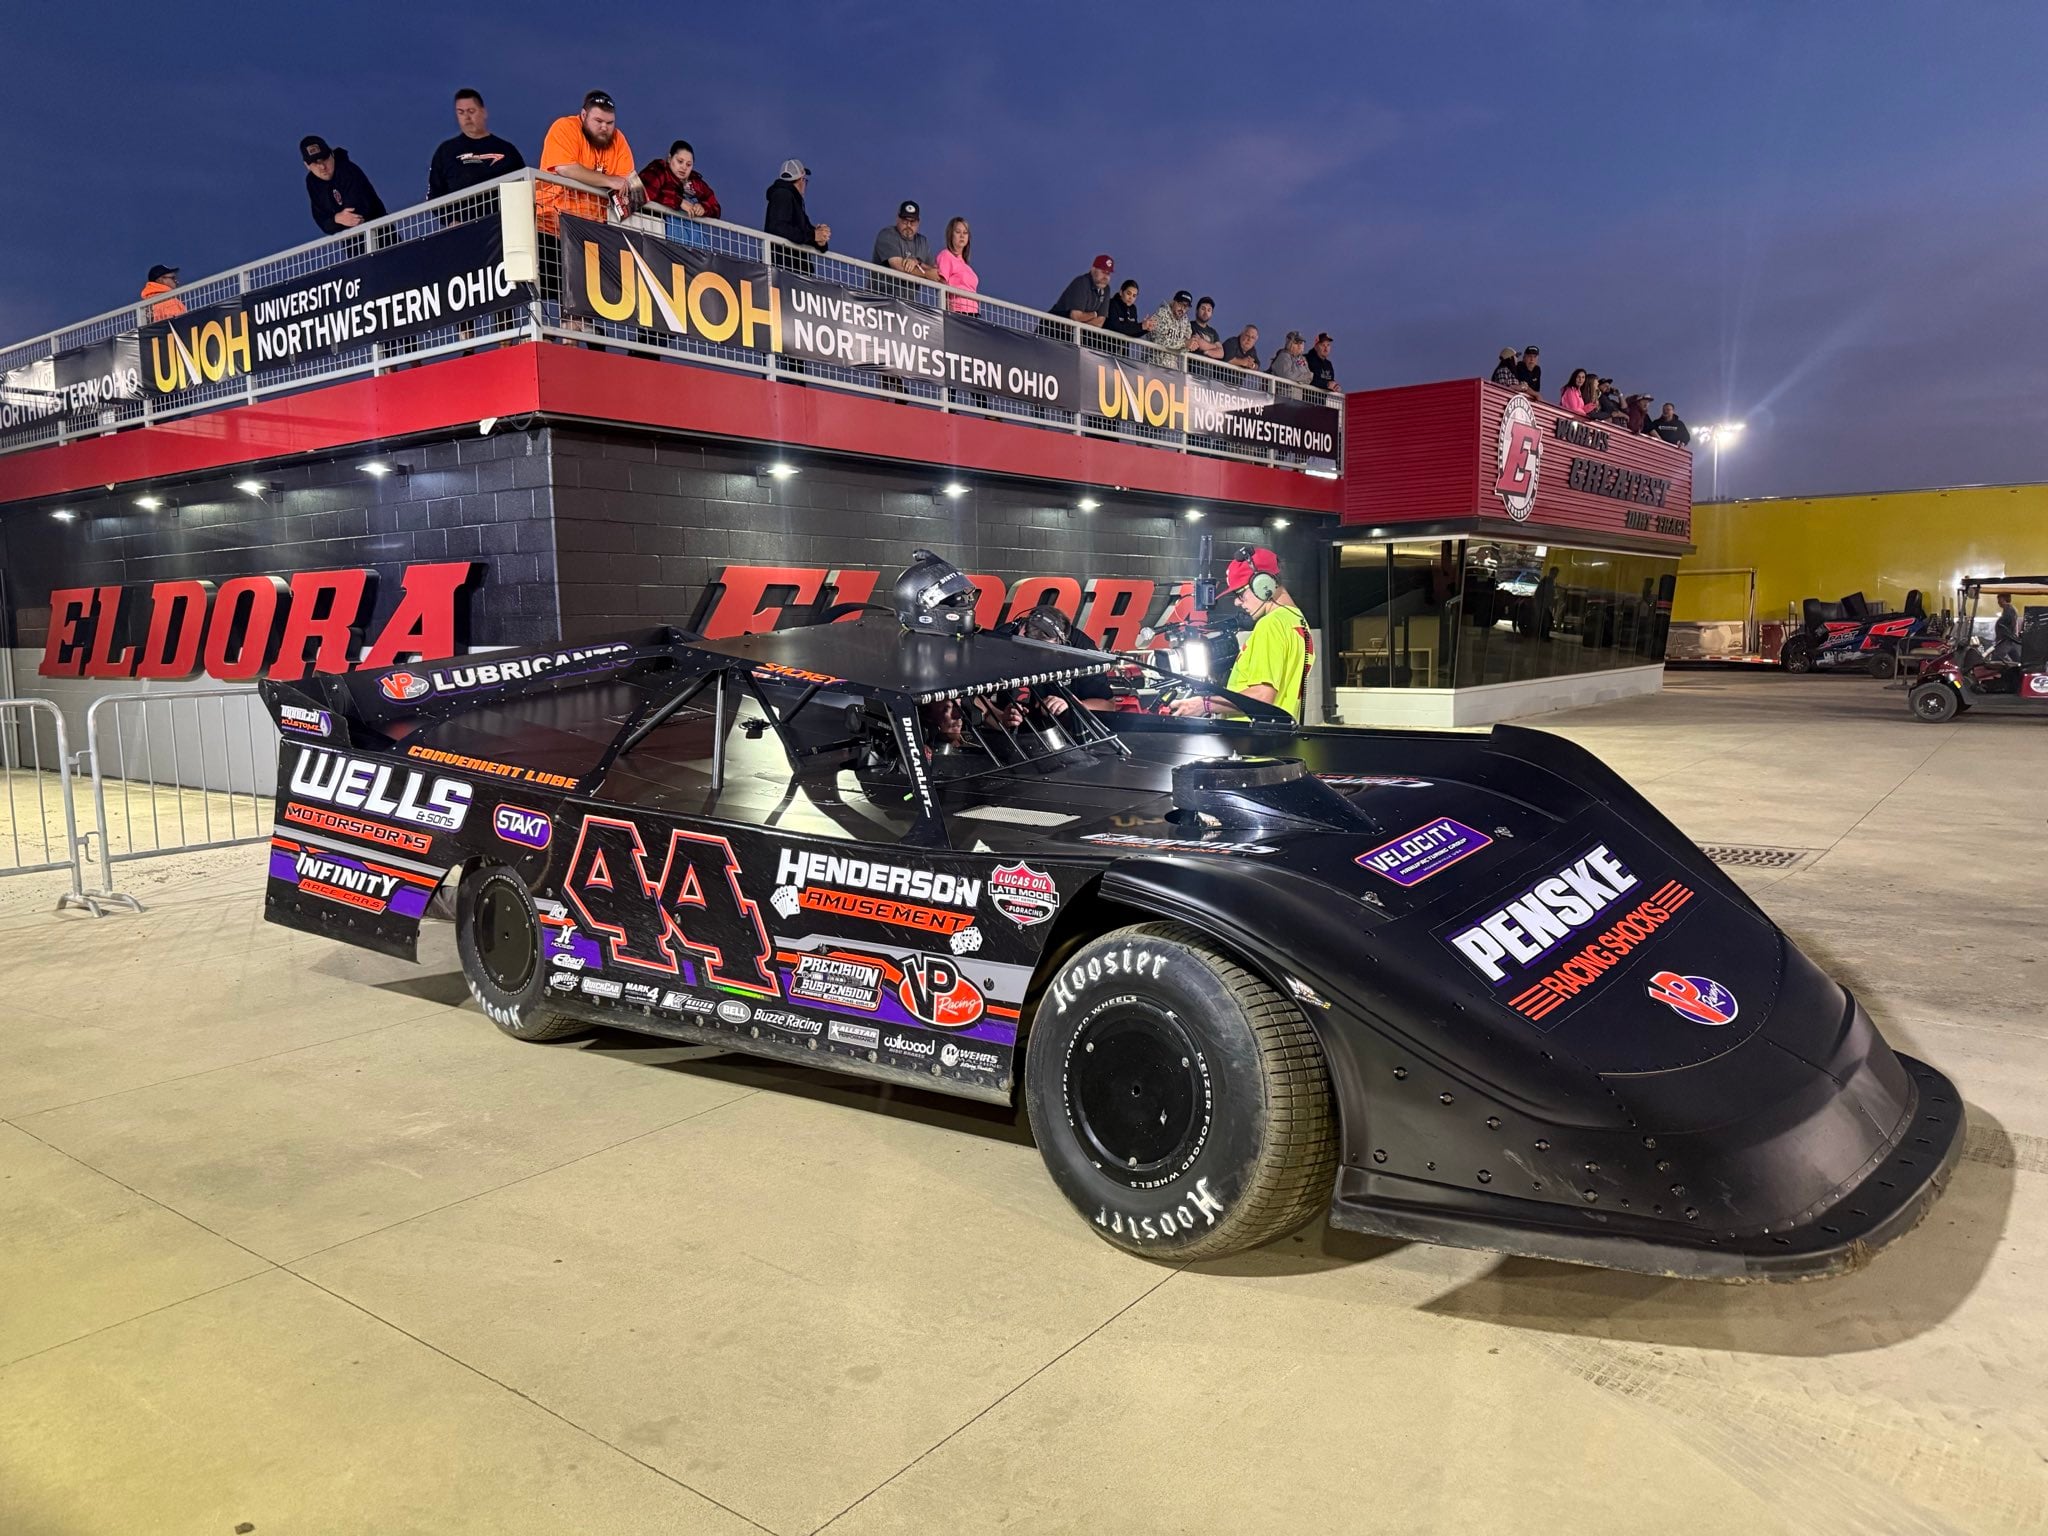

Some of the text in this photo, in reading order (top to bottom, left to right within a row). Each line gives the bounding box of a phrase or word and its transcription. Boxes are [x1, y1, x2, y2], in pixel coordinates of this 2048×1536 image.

[253, 278, 361, 324] UNIVERSITY OF
[257, 262, 512, 362] NORTHWESTERN OHIO
[584, 236, 783, 353] UNOH
[792, 288, 930, 341] UNIVERSITY OF
[152, 311, 253, 392] UNOH
[794, 320, 1059, 401] NORTHWESTERN OHIO
[0, 376, 99, 429] ORTHWESTERN
[100, 367, 137, 401] OHIO
[1098, 362, 1189, 432] UNOH
[1194, 387, 1265, 416] UNIVERSITY OF
[1194, 411, 1332, 453] NORTHWESTERN OHIO
[1569, 457, 1671, 508] GREATEST
[39, 562, 474, 682] ELDORA
[381, 672, 415, 700] VP
[290, 748, 473, 830] WELLS
[408, 745, 579, 789] CONVENIENT LUBE
[288, 806, 427, 849] MOTORSPORTS
[497, 810, 547, 838] STAKT
[1366, 822, 1457, 872] VELOCITY
[296, 851, 401, 897] INFINITY
[302, 881, 381, 909] RACE CARS
[776, 848, 981, 907] HENDERSON
[991, 885, 1017, 895] LATE
[1018, 889, 1057, 904] MODEL
[999, 873, 1047, 890] LUCAS OIL
[564, 814, 781, 997] 44
[806, 893, 966, 931] AMUSEMENT
[1451, 845, 1638, 982] PENSKE
[797, 956, 881, 988] PRECISION
[1540, 901, 1671, 999] RACING SHOCKS
[625, 982, 649, 994] MARK
[647, 987, 659, 1000] 4
[801, 979, 873, 1001] SUSPENSION
[902, 954, 982, 1022] VP Racing
[1052, 943, 1168, 1014] Hoosier
[722, 1005, 745, 1017] BELL
[754, 1009, 823, 1035] Buzze Racing
[1091, 995, 1137, 1014] WHEELS
[839, 1026, 877, 1037] ALLSTAR
[884, 1034, 935, 1055] wilwood
[960, 1049, 998, 1064] WEHRS
[1130, 1052, 1212, 1189] KEIZER FORGED WHEELS
[1096, 1177, 1225, 1247] Hoosier
